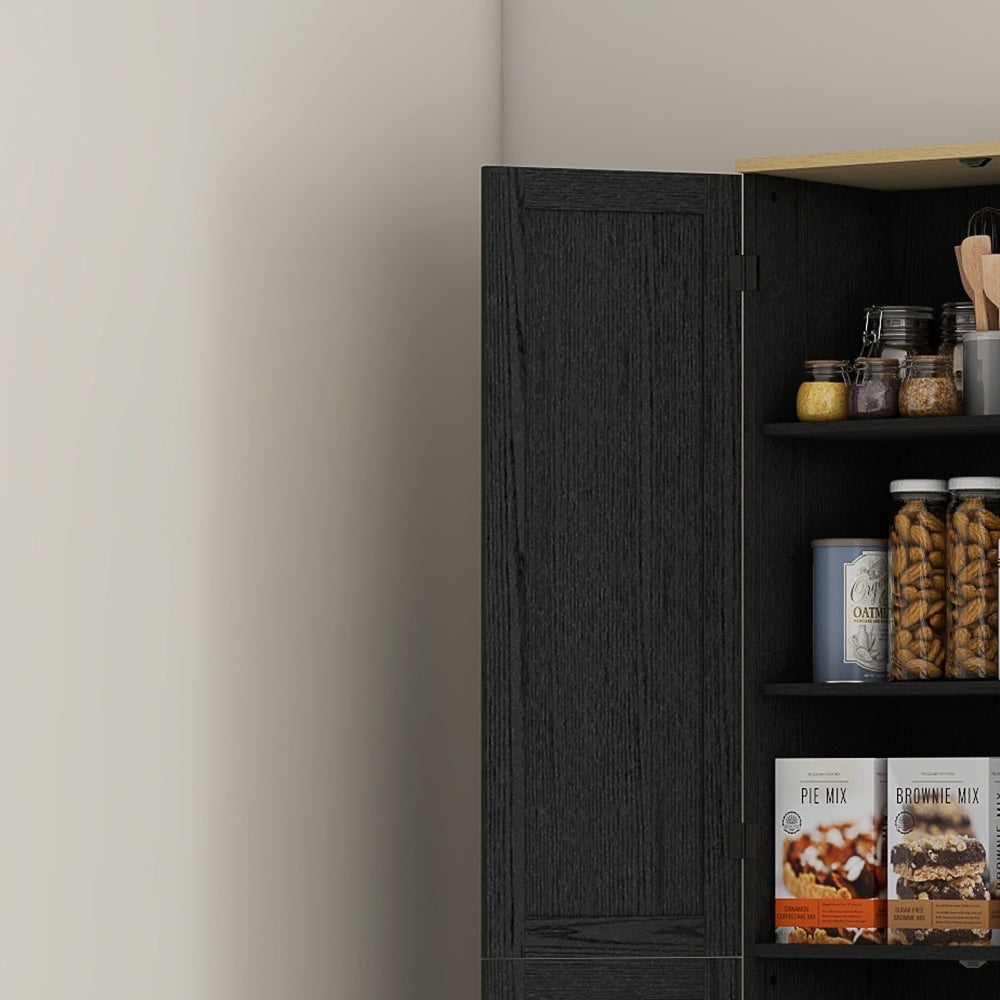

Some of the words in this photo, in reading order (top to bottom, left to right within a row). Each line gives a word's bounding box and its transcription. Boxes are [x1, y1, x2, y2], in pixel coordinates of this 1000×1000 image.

[801, 787, 820, 804] PIE
[826, 787, 847, 804] MIX
[896, 787, 951, 804] BROWNIE
[958, 787, 980, 804] MIX
